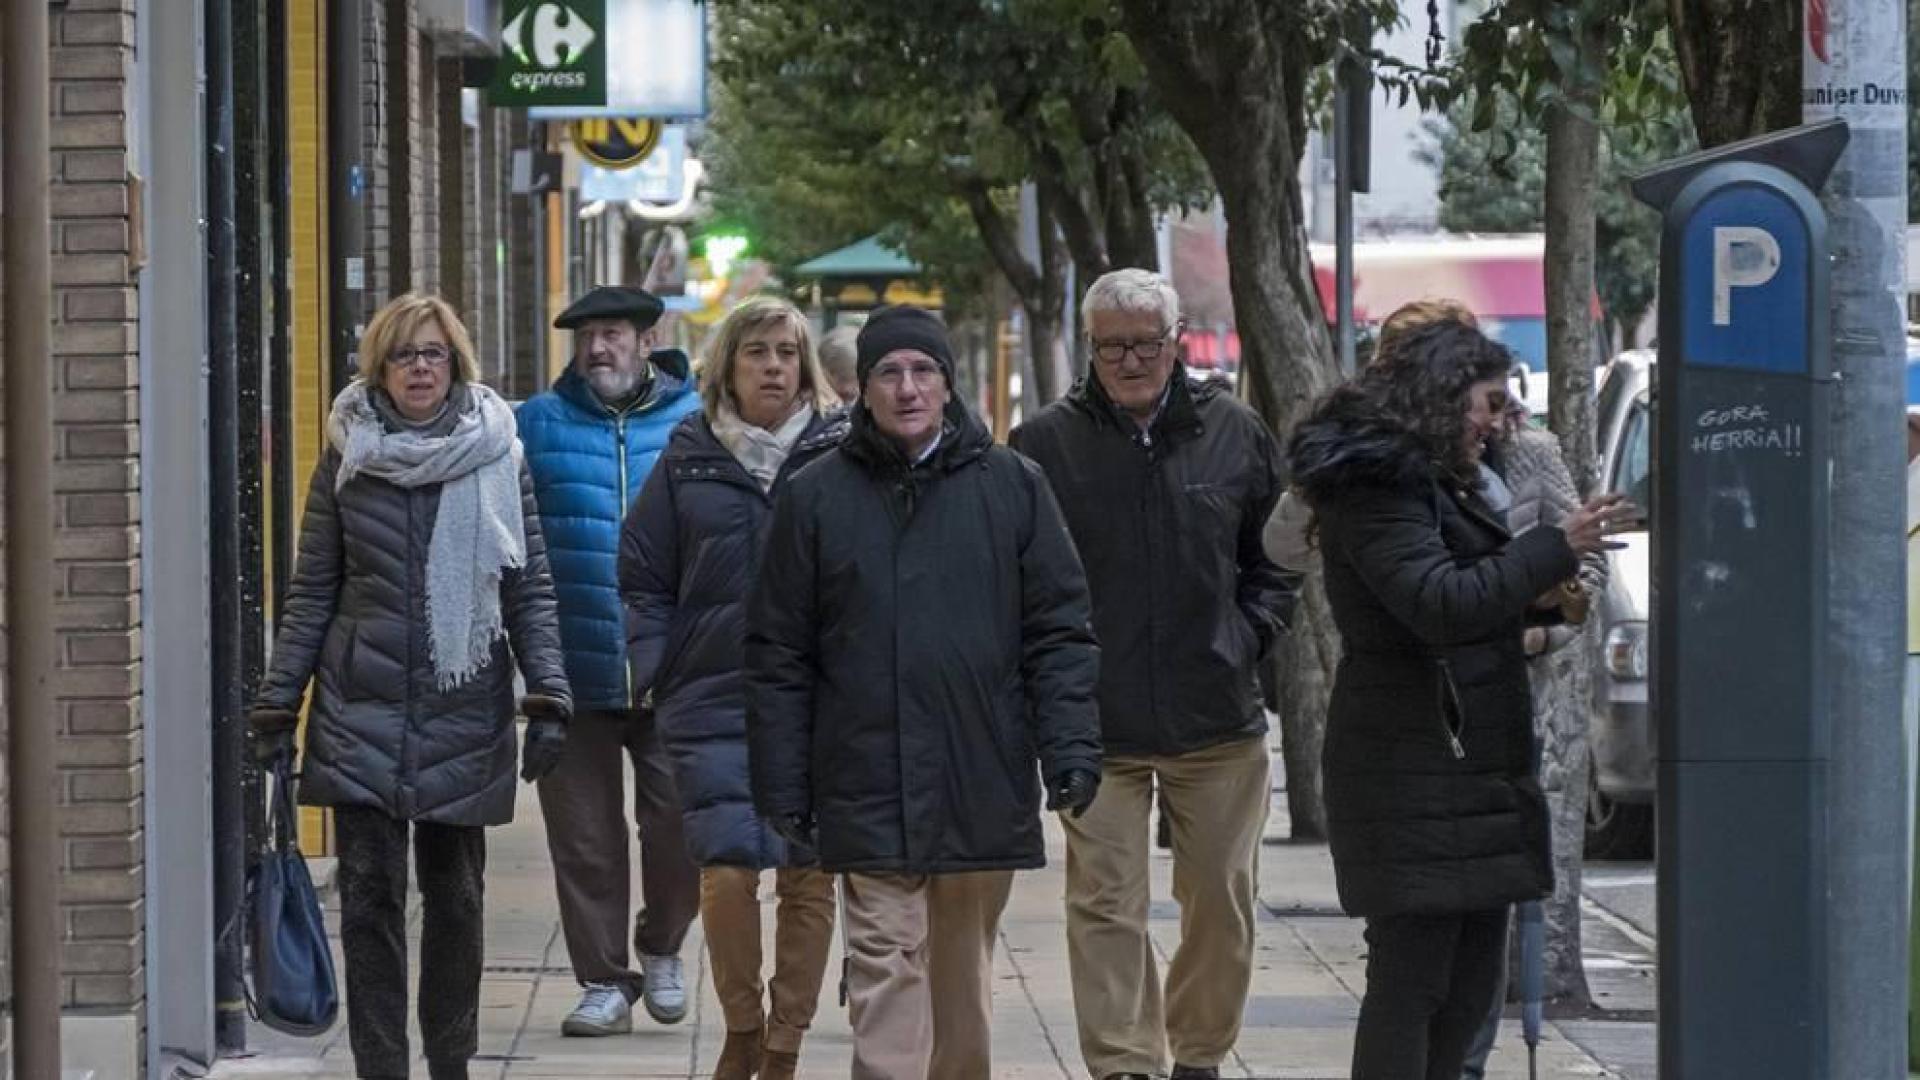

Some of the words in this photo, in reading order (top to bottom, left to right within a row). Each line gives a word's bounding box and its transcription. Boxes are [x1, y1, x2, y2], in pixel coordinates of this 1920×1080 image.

[511, 71, 586, 92] express
[1805, 82, 1859, 105] nier
[1713, 226, 1781, 325] P
